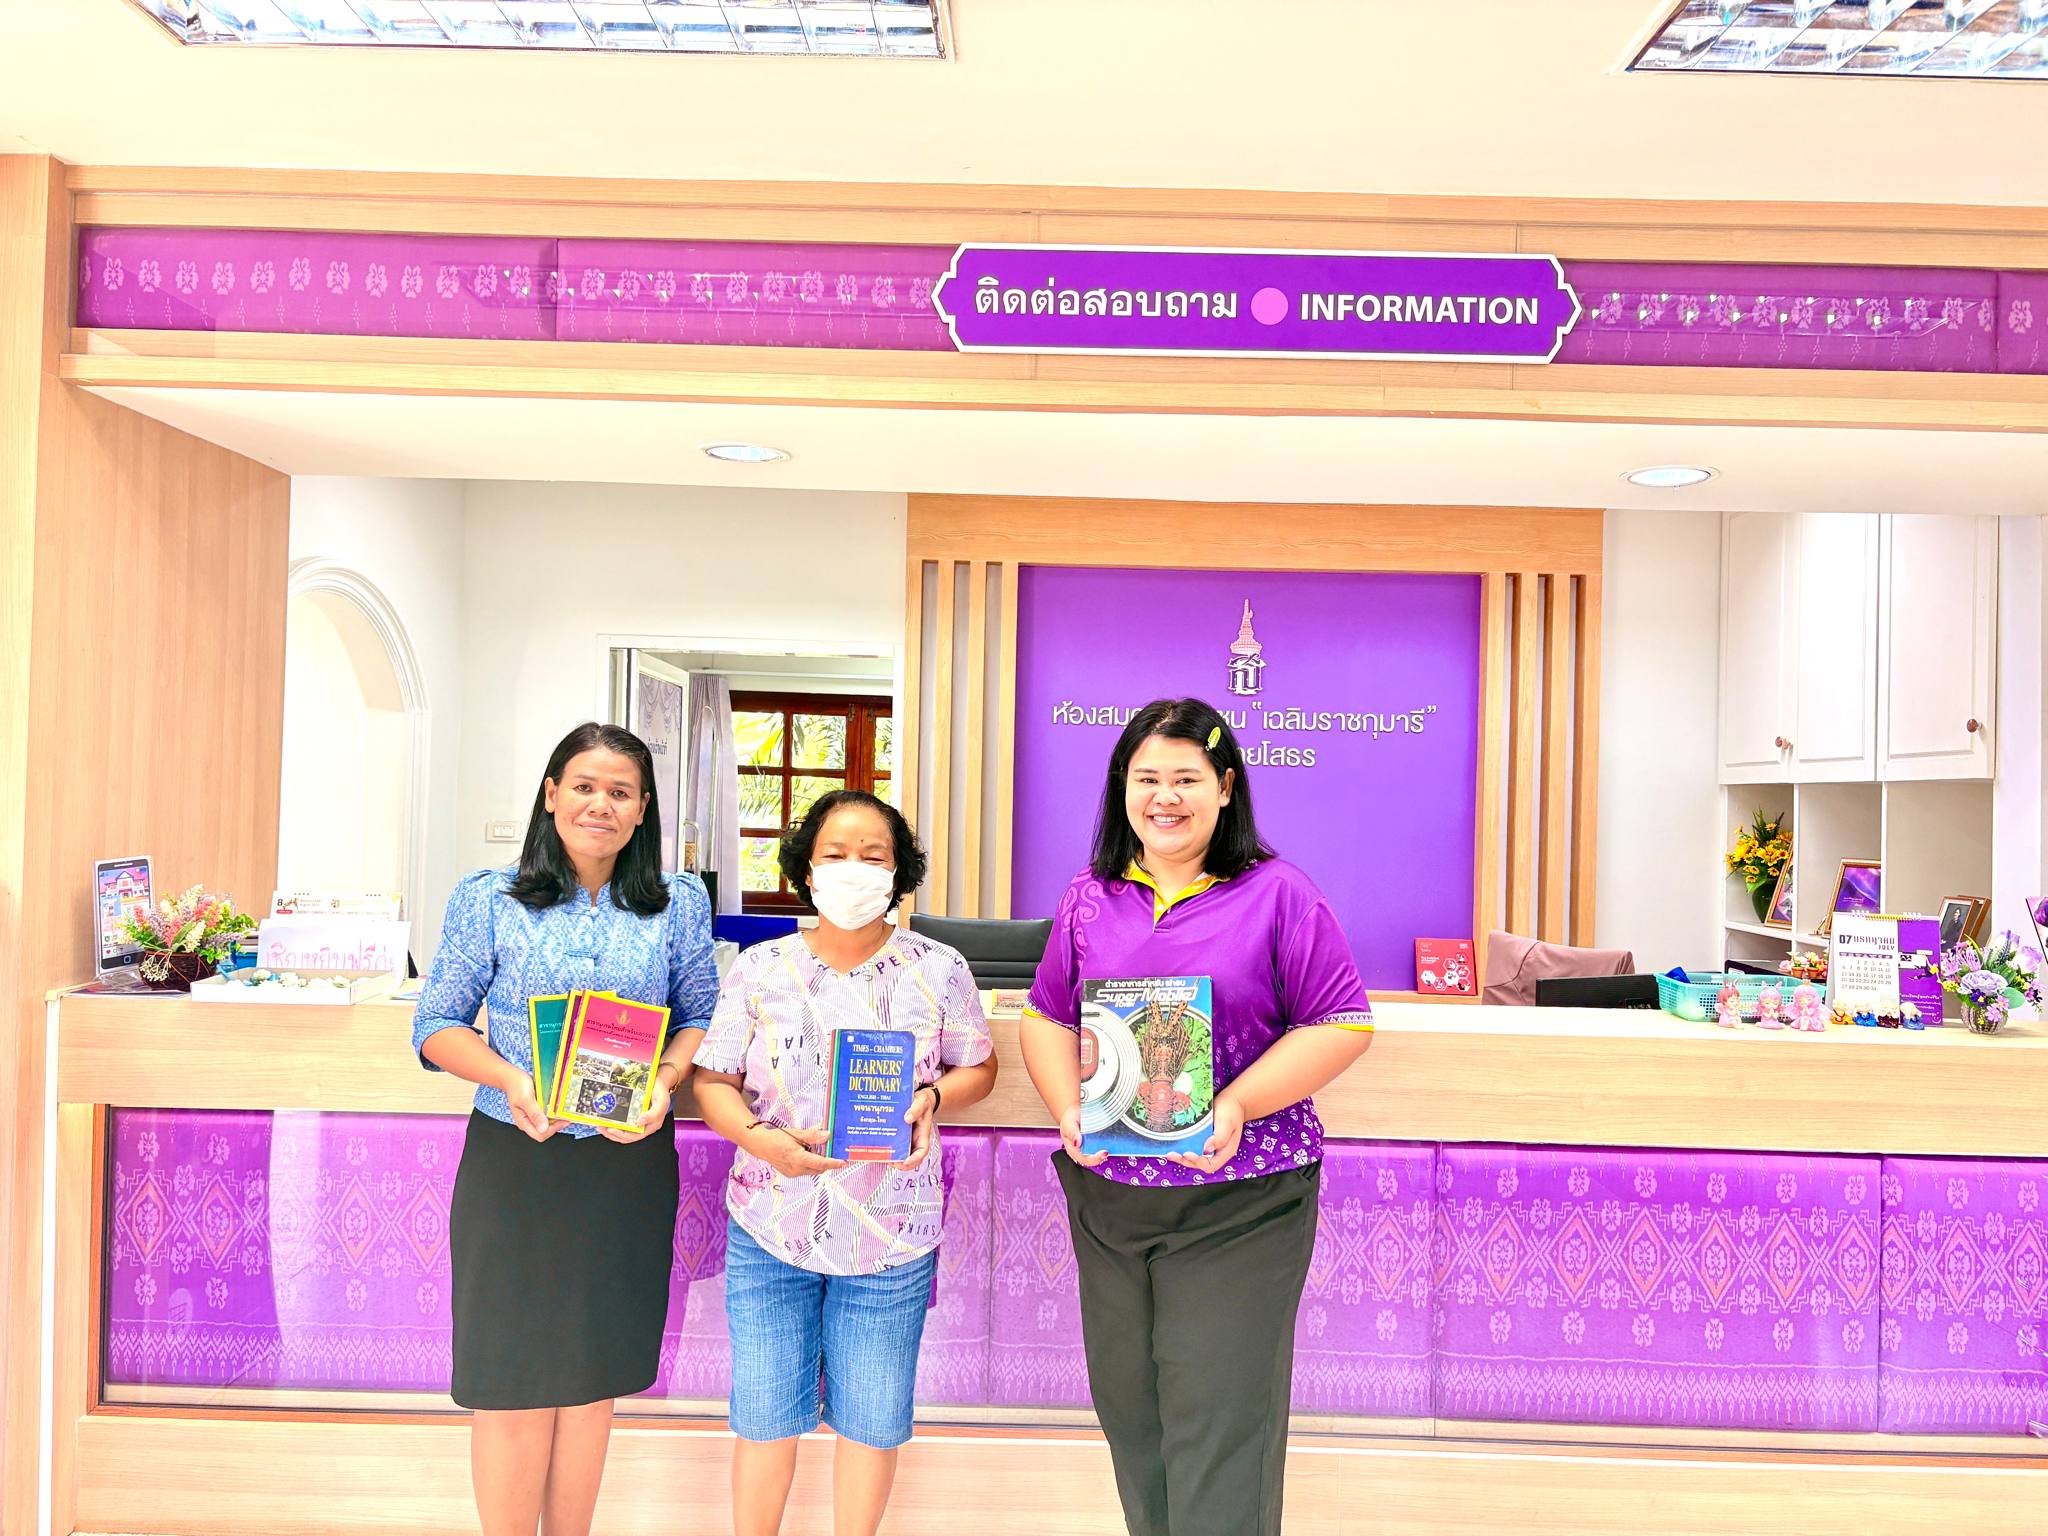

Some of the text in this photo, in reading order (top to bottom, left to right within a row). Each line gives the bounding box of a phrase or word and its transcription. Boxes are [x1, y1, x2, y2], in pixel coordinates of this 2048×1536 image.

[974, 275, 1539, 325] ติดต่อสอบถาม INFORMATION
[1839, 934, 1852, 944] 07
[853, 1044, 870, 1053] TIMES
[873, 1045, 904, 1054] CHAMBERS
[849, 1058, 905, 1076] LEARNERS'
[848, 1076, 902, 1093] DICTIONARY
